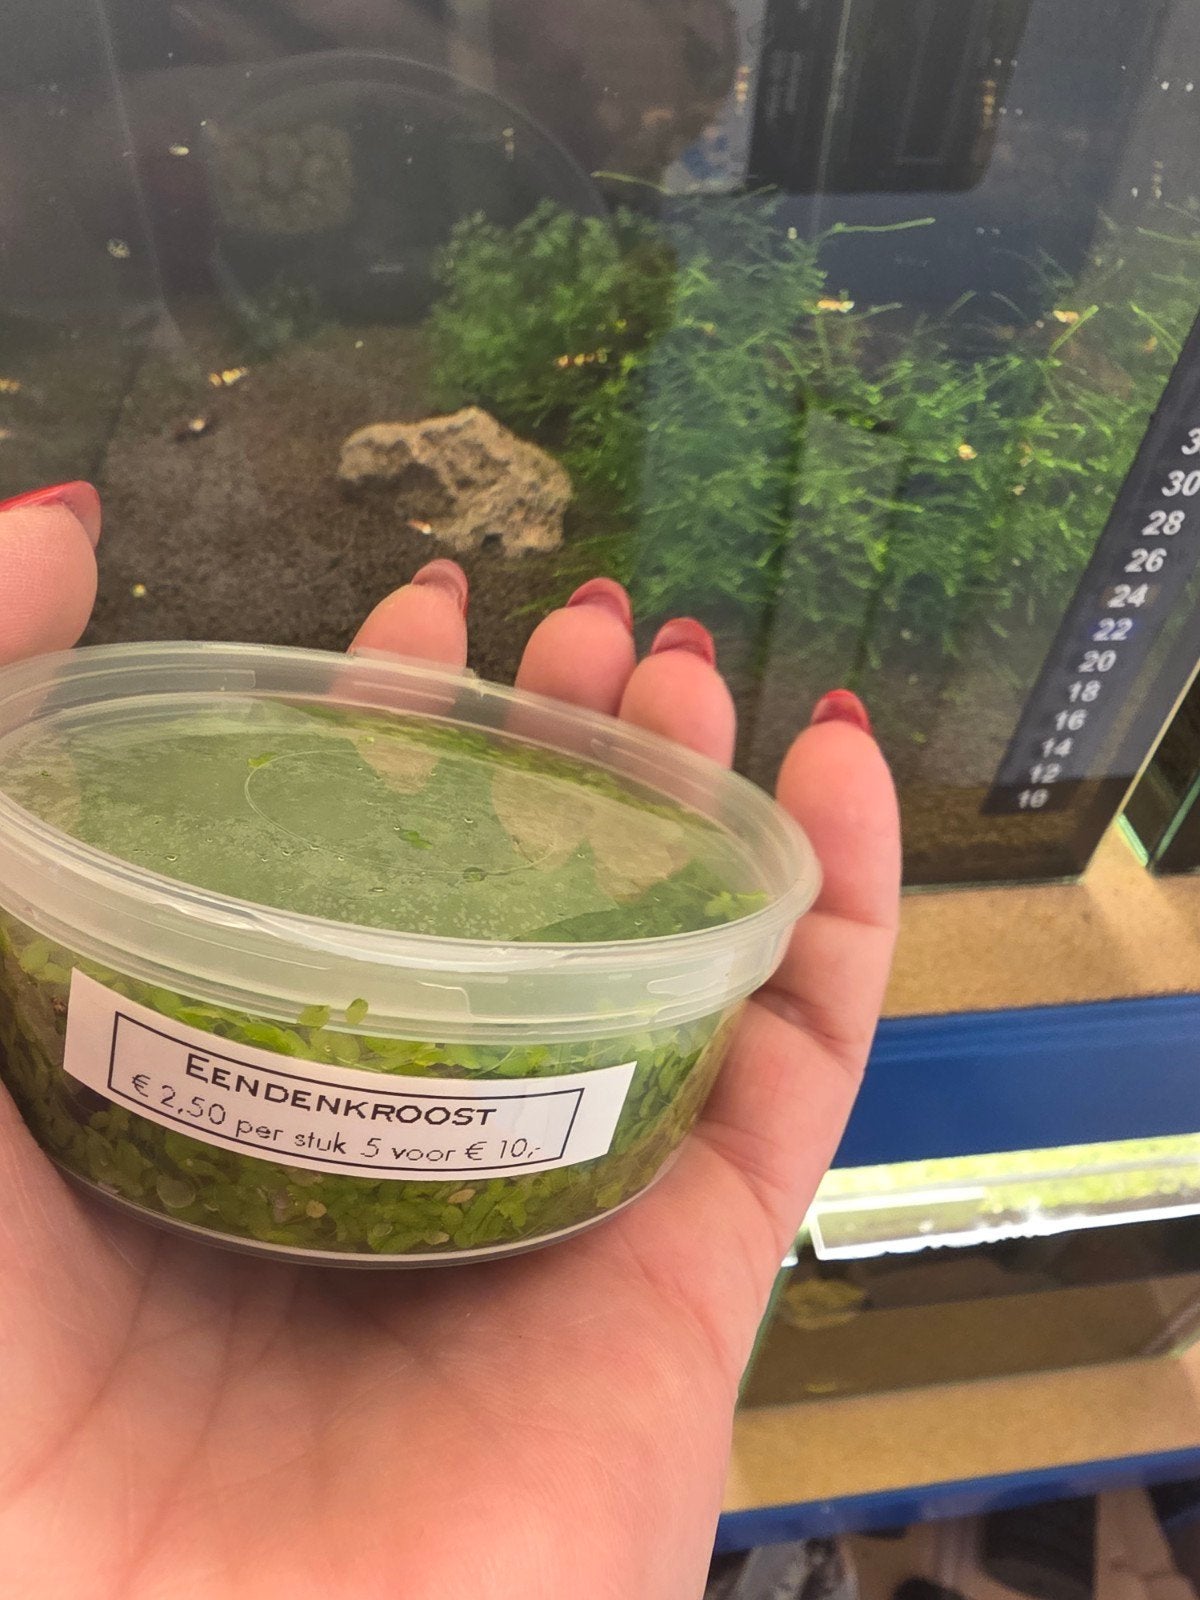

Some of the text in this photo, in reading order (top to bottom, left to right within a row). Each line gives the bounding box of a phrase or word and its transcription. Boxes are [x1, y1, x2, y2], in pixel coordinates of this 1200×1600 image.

[1181, 427, 1200, 455] 3
[1161, 469, 1200, 497] 30
[1142, 510, 1186, 536] 28
[1124, 548, 1168, 573] 26
[1108, 583, 1149, 608] 24
[1093, 617, 1134, 642] 22
[1078, 649, 1117, 673] 20
[1069, 680, 1101, 703] 18
[1056, 708, 1088, 731] 16
[1042, 737, 1074, 758] 14
[1030, 763, 1062, 784] 12
[1018, 788, 1050, 809] 10
[185, 1052, 497, 1126] EENDENKROOST
[131, 1073, 541, 1163] € 2,50 per stuk 5 voor € 10,-
